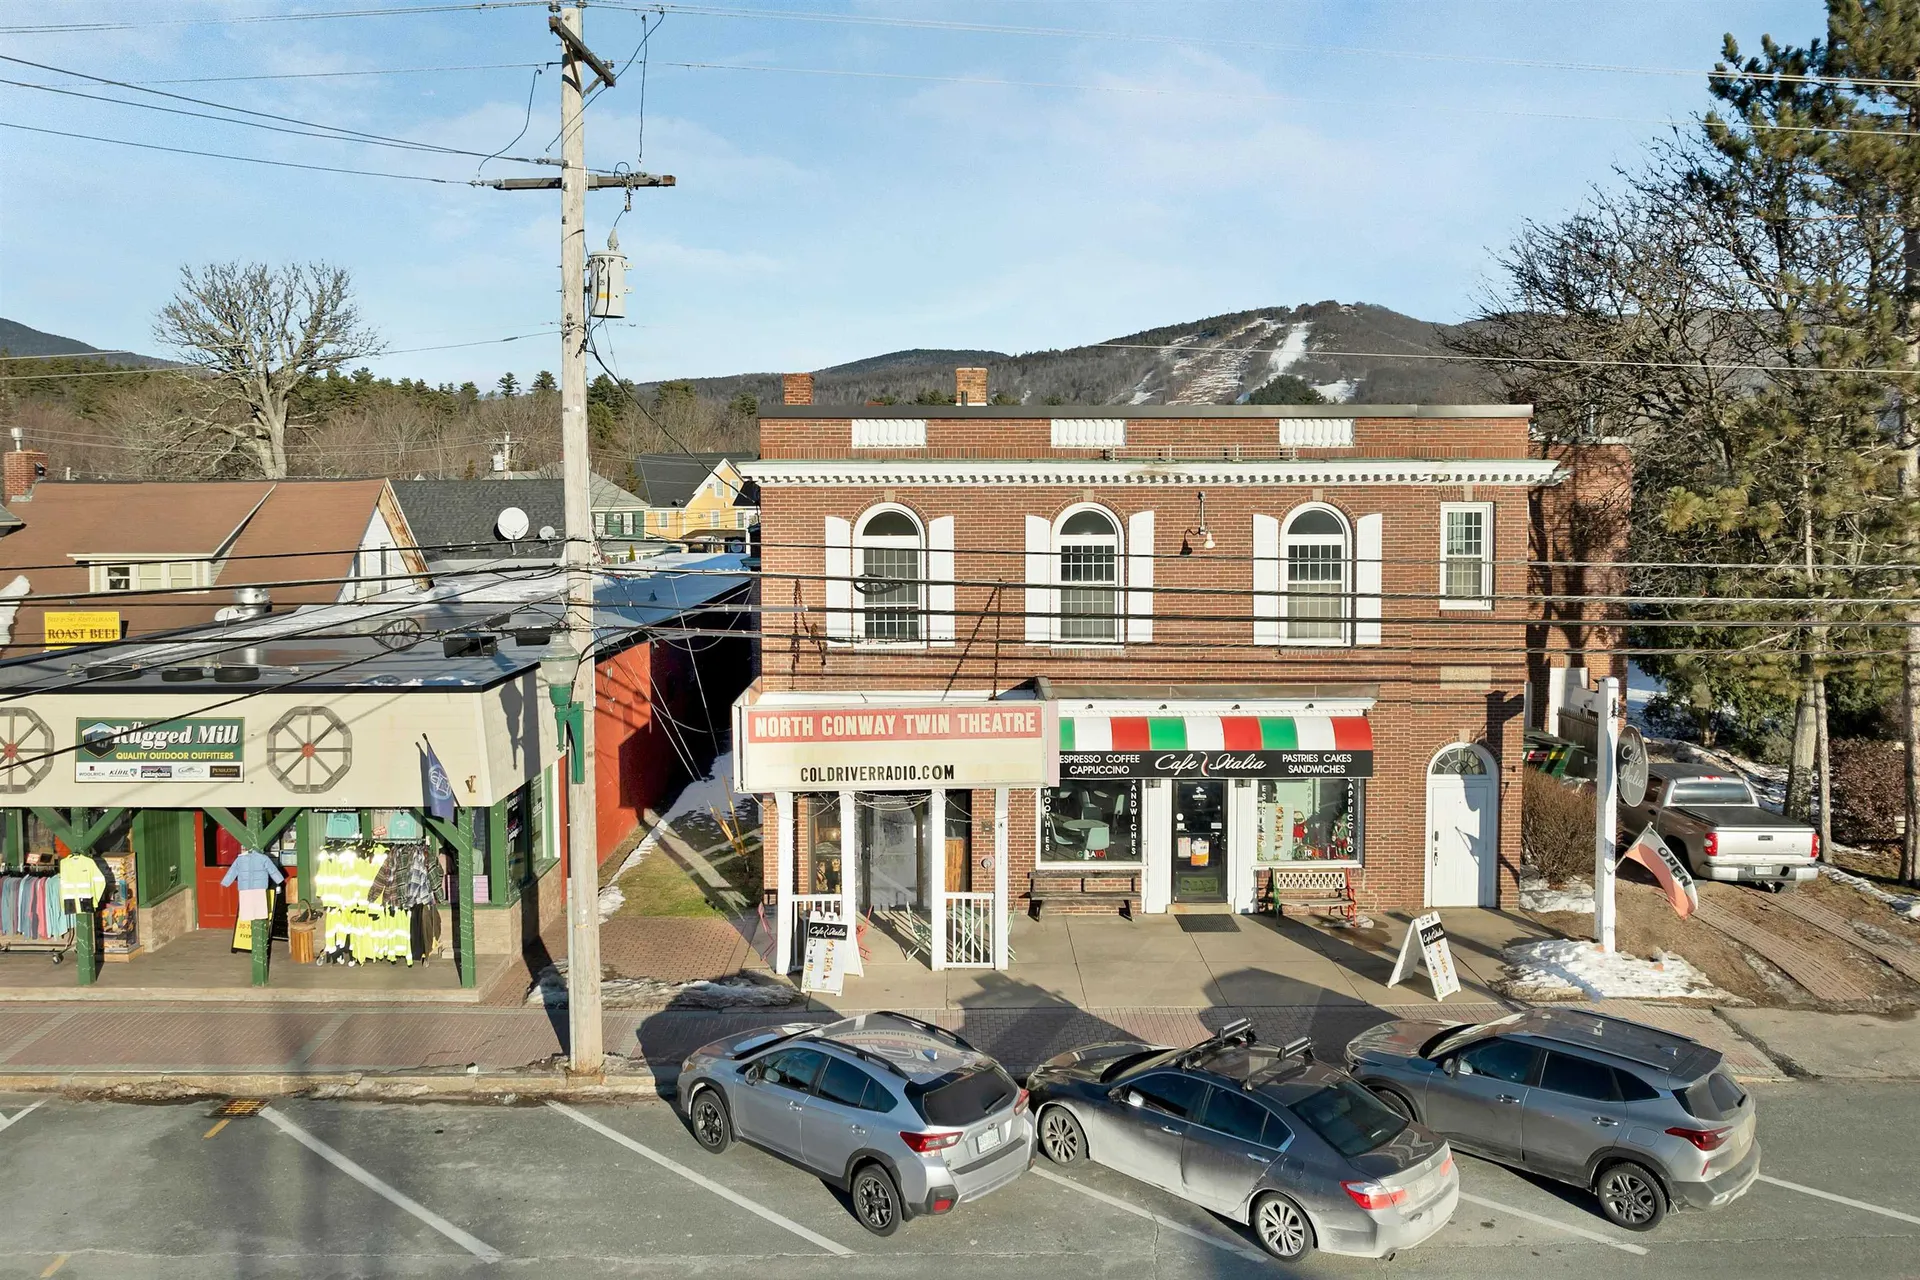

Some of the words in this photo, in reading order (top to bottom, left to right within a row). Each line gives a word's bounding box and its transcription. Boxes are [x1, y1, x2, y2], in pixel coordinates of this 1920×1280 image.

[48, 628, 87, 639] ROAST
[90, 628, 118, 639] BEEF
[755, 716, 814, 737] NORTH
[821, 715, 897, 736] CONWAY
[904, 713, 950, 735] TWIN
[958, 712, 1036, 733] THEATRE
[112, 725, 192, 750] Rugged
[197, 725, 239, 744] Mill
[116, 752, 148, 760] QUALITY
[149, 752, 190, 760] OUTDOOR
[191, 752, 234, 760] OUTFITTERS
[1059, 755, 1101, 764] ESPRESSO
[1105, 755, 1140, 763] COFFEE
[1154, 753, 1198, 776] Cafe
[1208, 753, 1267, 771] Italia
[1282, 754, 1319, 763] PASTRIES
[1323, 754, 1352, 763] CAKES
[1620, 744, 1643, 768] Cafe
[800, 764, 955, 782] COLDRIVERRADIO.COM
[1069, 765, 1130, 775] CAPPUCCINO
[1288, 764, 1346, 774] SANDWICHES
[1618, 764, 1645, 788] Italia
[1130, 779, 1138, 855] SANDWICHES
[1657, 847, 1692, 888] OPEN
[810, 926, 825, 937] Cafe
